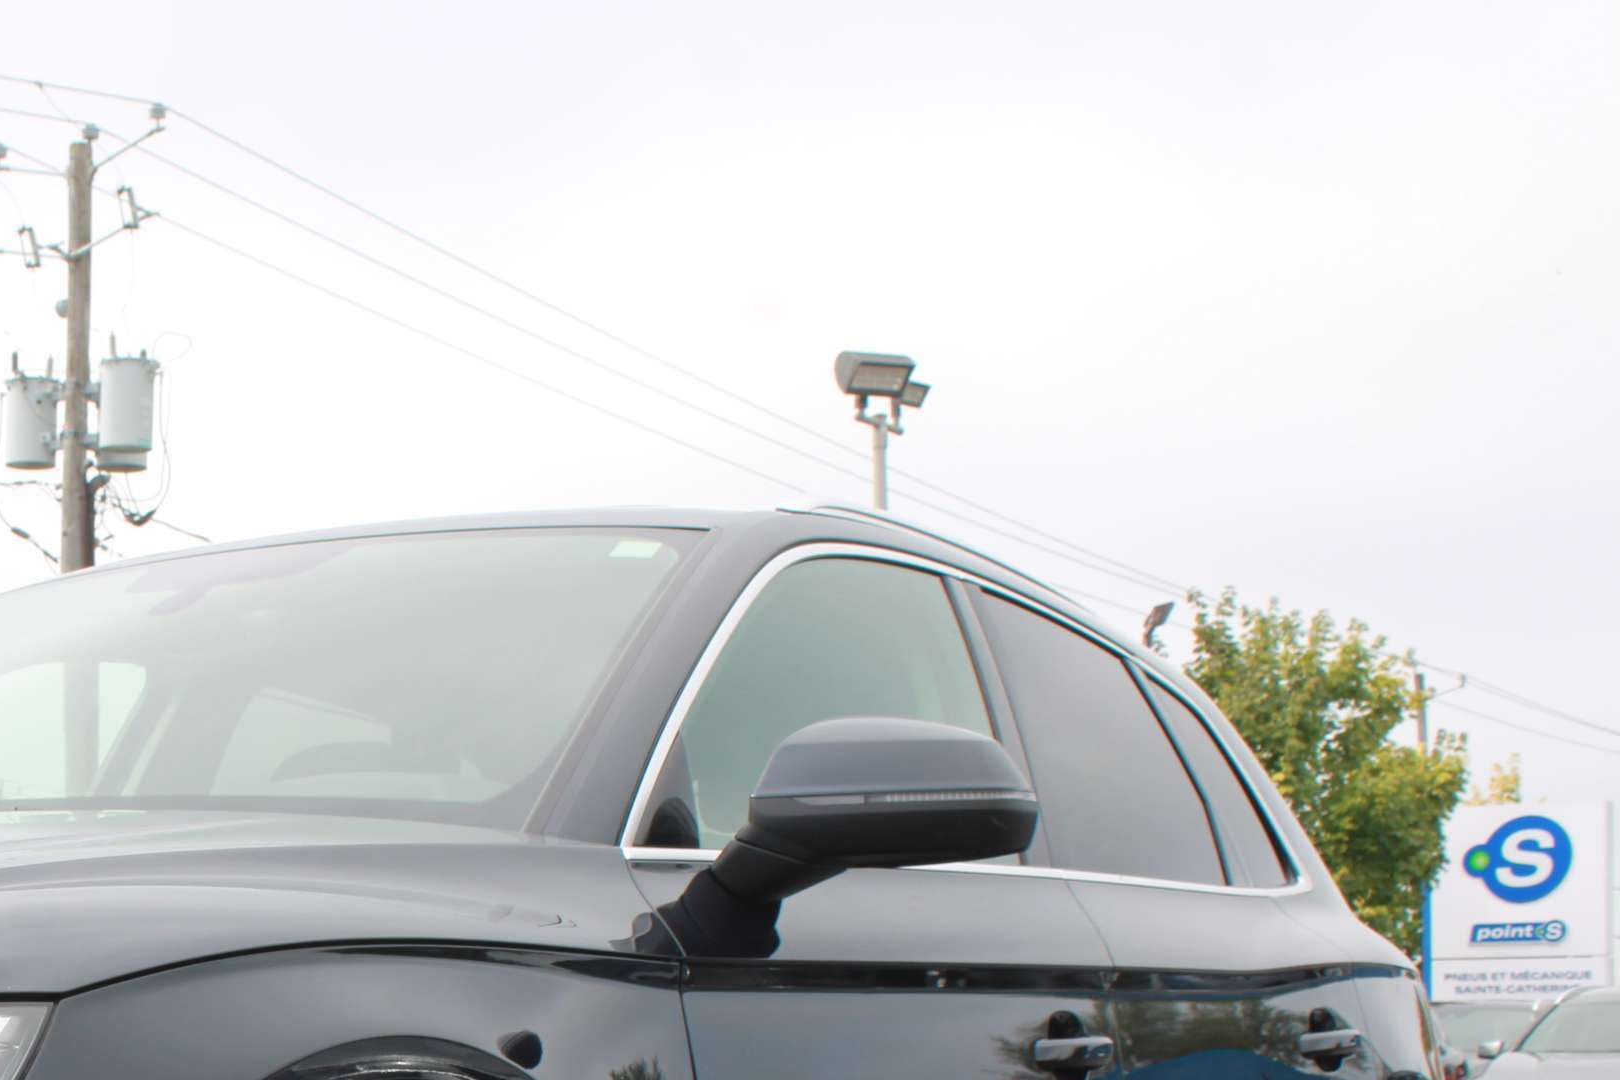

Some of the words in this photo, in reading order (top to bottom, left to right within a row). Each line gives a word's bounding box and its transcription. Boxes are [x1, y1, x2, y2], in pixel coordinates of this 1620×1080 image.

[1495, 828, 1556, 888] S
[1476, 924, 1533, 941] point
[1444, 972, 1487, 982] PNEUS
[1491, 971, 1506, 981] ET
